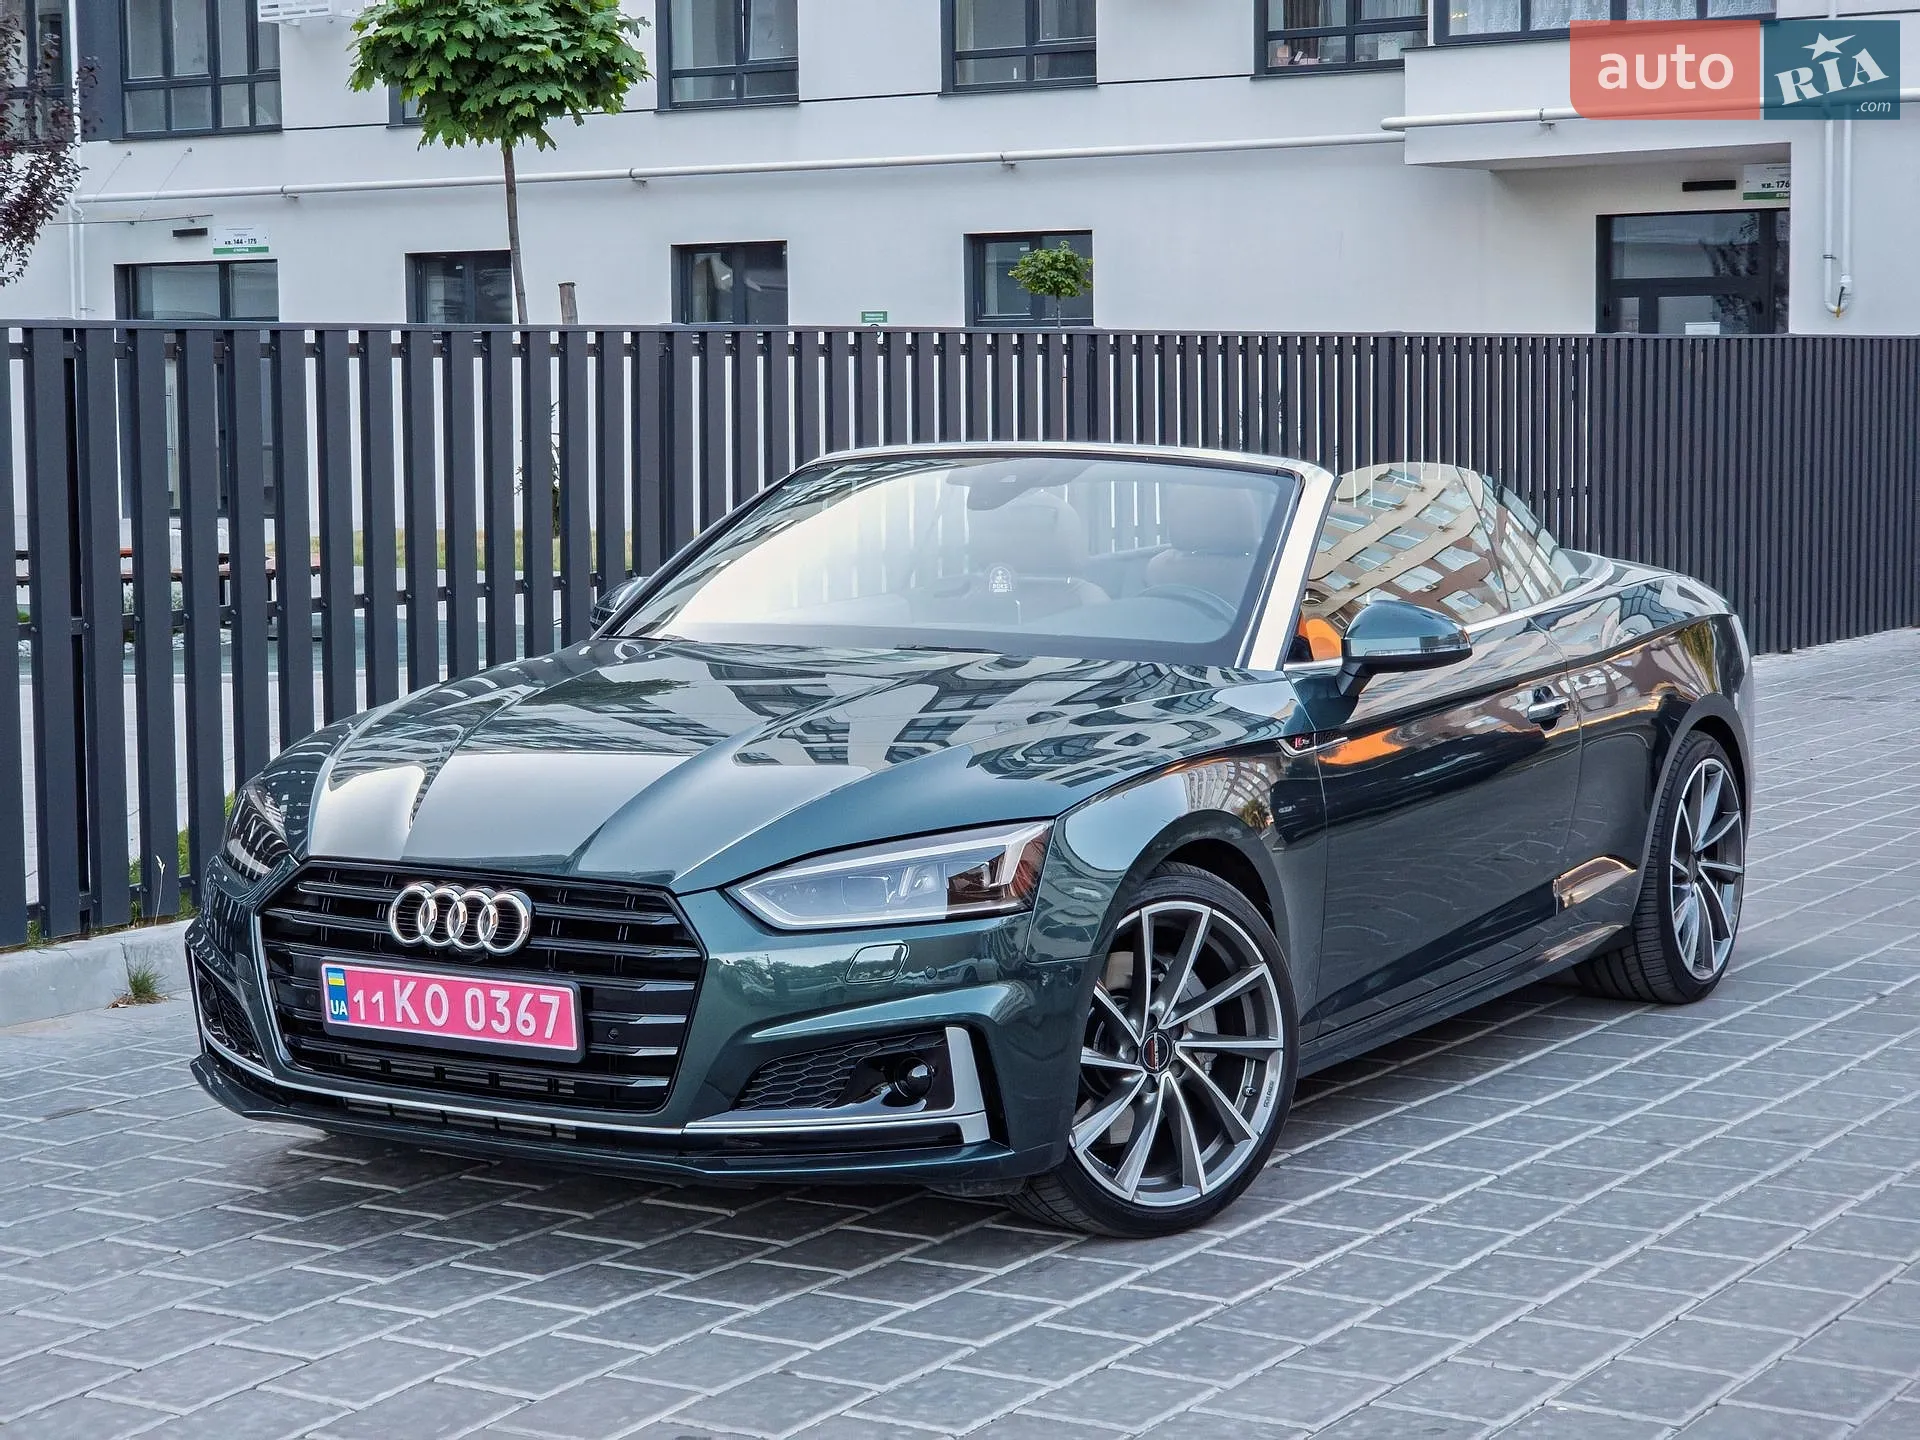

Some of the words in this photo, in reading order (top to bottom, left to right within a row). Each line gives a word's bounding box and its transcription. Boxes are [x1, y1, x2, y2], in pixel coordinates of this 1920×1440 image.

[1775, 180, 1790, 188] 176
[330, 999, 348, 1016] UA
[464, 987, 560, 1039] 0367
